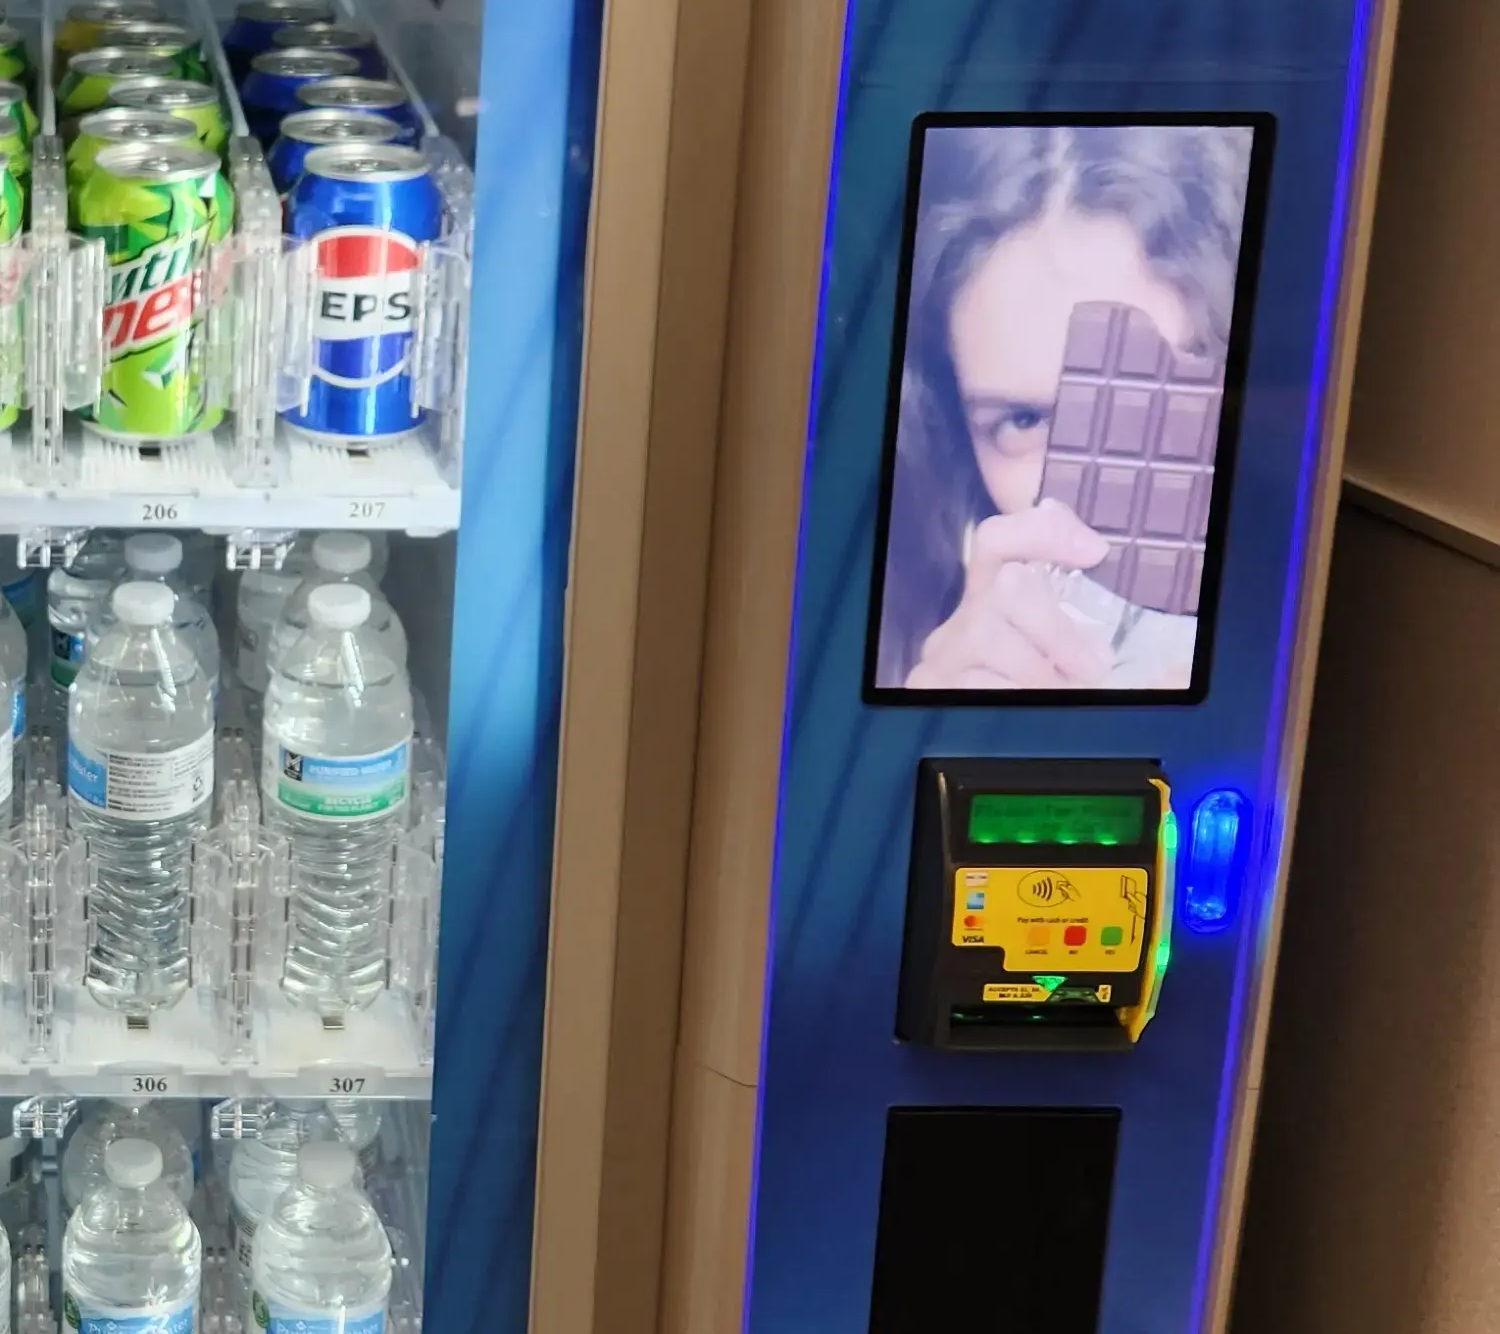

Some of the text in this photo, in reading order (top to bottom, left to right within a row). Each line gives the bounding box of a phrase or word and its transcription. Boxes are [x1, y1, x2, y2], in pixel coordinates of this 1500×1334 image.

[320, 292, 411, 322] EPS
[142, 505, 178, 520] 206
[350, 502, 385, 518] 207
[961, 935, 985, 944] VISA
[133, 1078, 168, 1092] 306
[330, 1078, 365, 1093] 307
